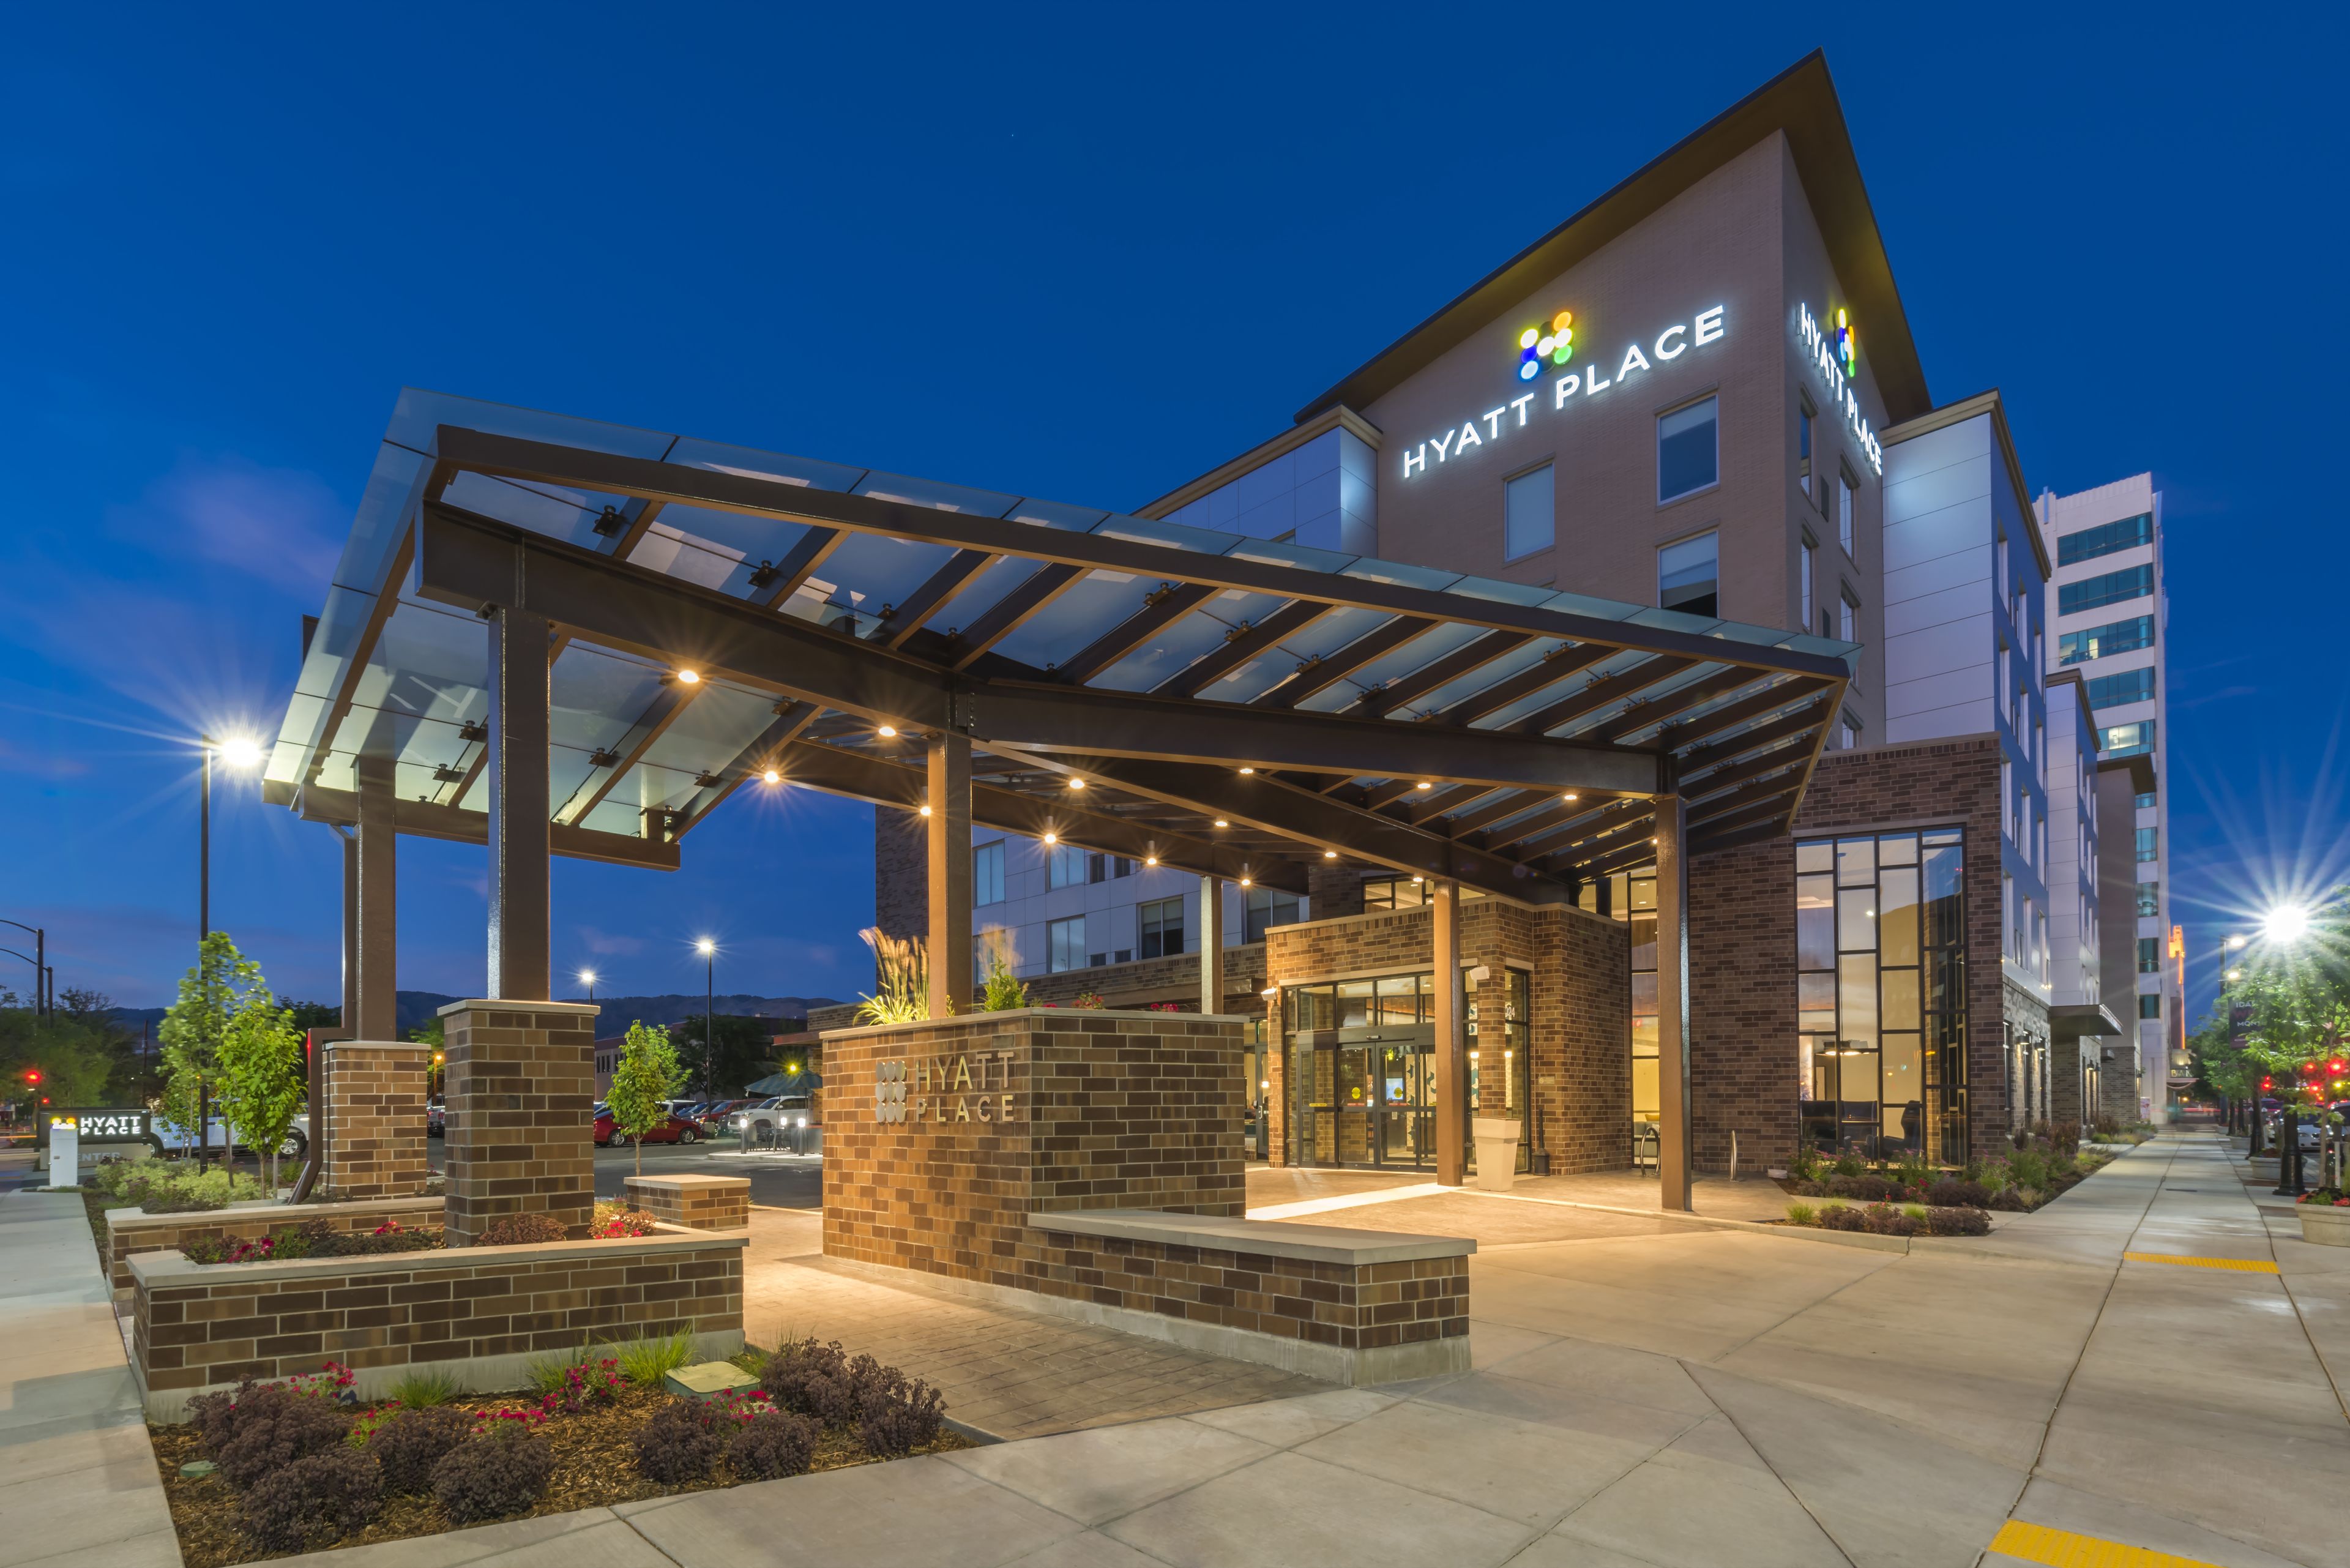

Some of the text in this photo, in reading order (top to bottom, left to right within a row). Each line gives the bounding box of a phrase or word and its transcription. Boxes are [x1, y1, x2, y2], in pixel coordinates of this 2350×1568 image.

[1404, 305, 1724, 478] HYATT PLACE
[1800, 302, 1882, 476] HYATT PLACE
[916, 1051, 1015, 1092] HYATT
[80, 1116, 141, 1128] HYATT
[916, 1095, 1015, 1123] PLACE
[80, 1126, 141, 1136] PLACE
